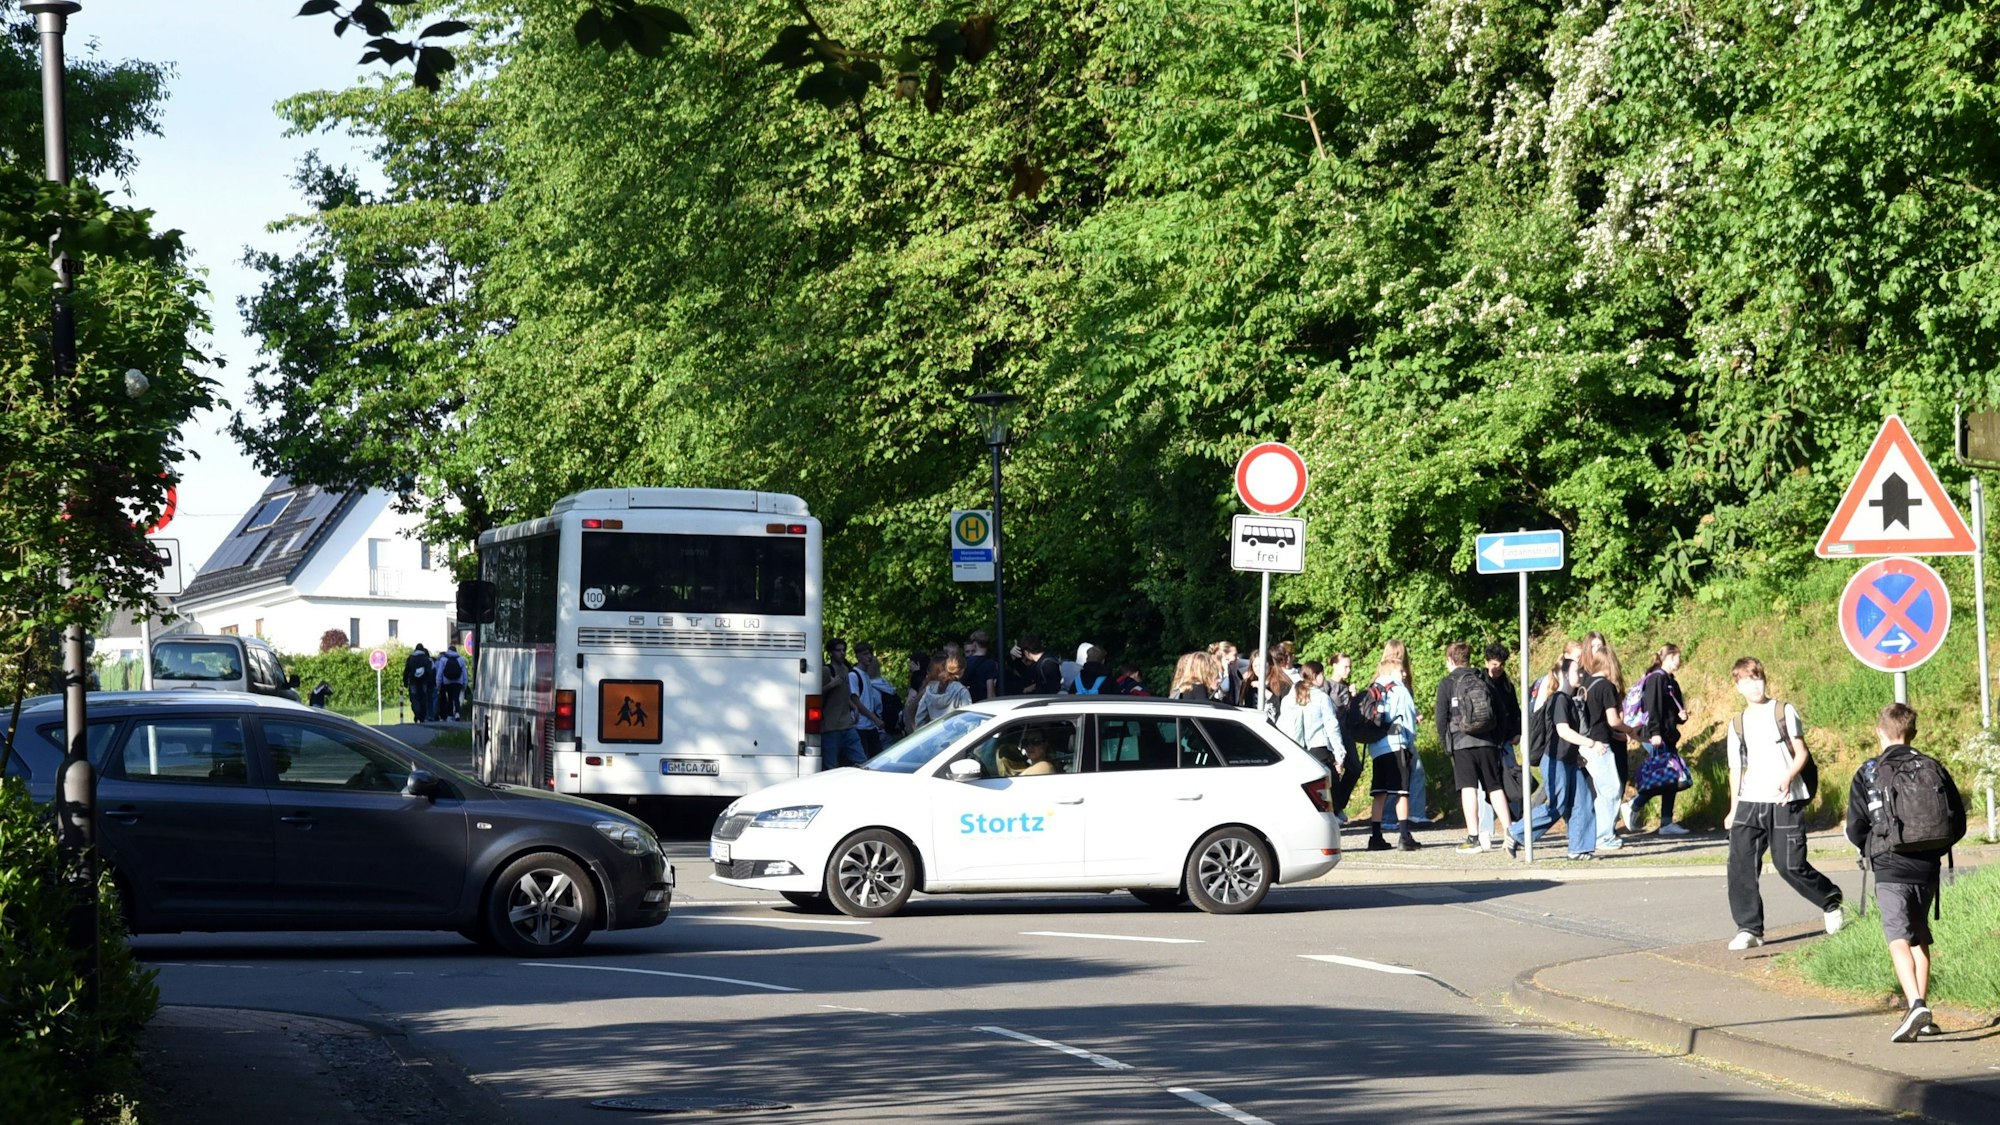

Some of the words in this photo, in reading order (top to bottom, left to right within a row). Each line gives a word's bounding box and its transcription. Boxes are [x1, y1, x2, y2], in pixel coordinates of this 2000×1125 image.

[965, 519, 979, 539] H
[1257, 551, 1279, 562] frei
[586, 592, 603, 603] 100
[628, 615, 759, 629] SETRA
[668, 763, 680, 772] GM
[686, 763, 698, 772] CA
[701, 763, 717, 773] 700
[960, 813, 1044, 834] Stortz
